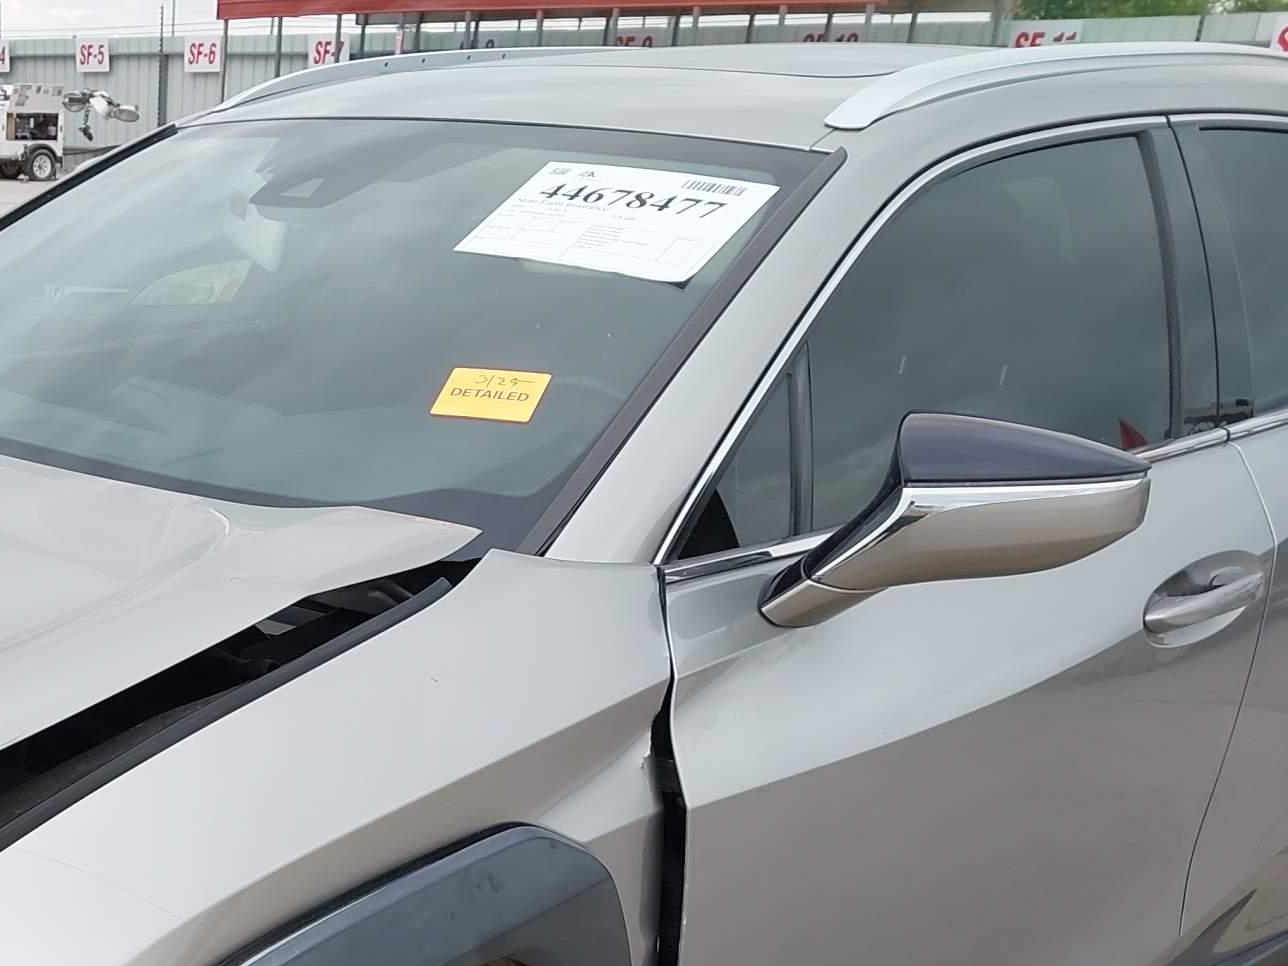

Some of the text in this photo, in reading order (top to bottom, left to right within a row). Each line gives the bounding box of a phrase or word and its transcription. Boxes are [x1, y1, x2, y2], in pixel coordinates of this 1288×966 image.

[79, 43, 105, 65] SF-5
[187, 42, 217, 65] SF-6
[540, 183, 728, 218] 44678477
[450, 387, 530, 402] DETAILED
